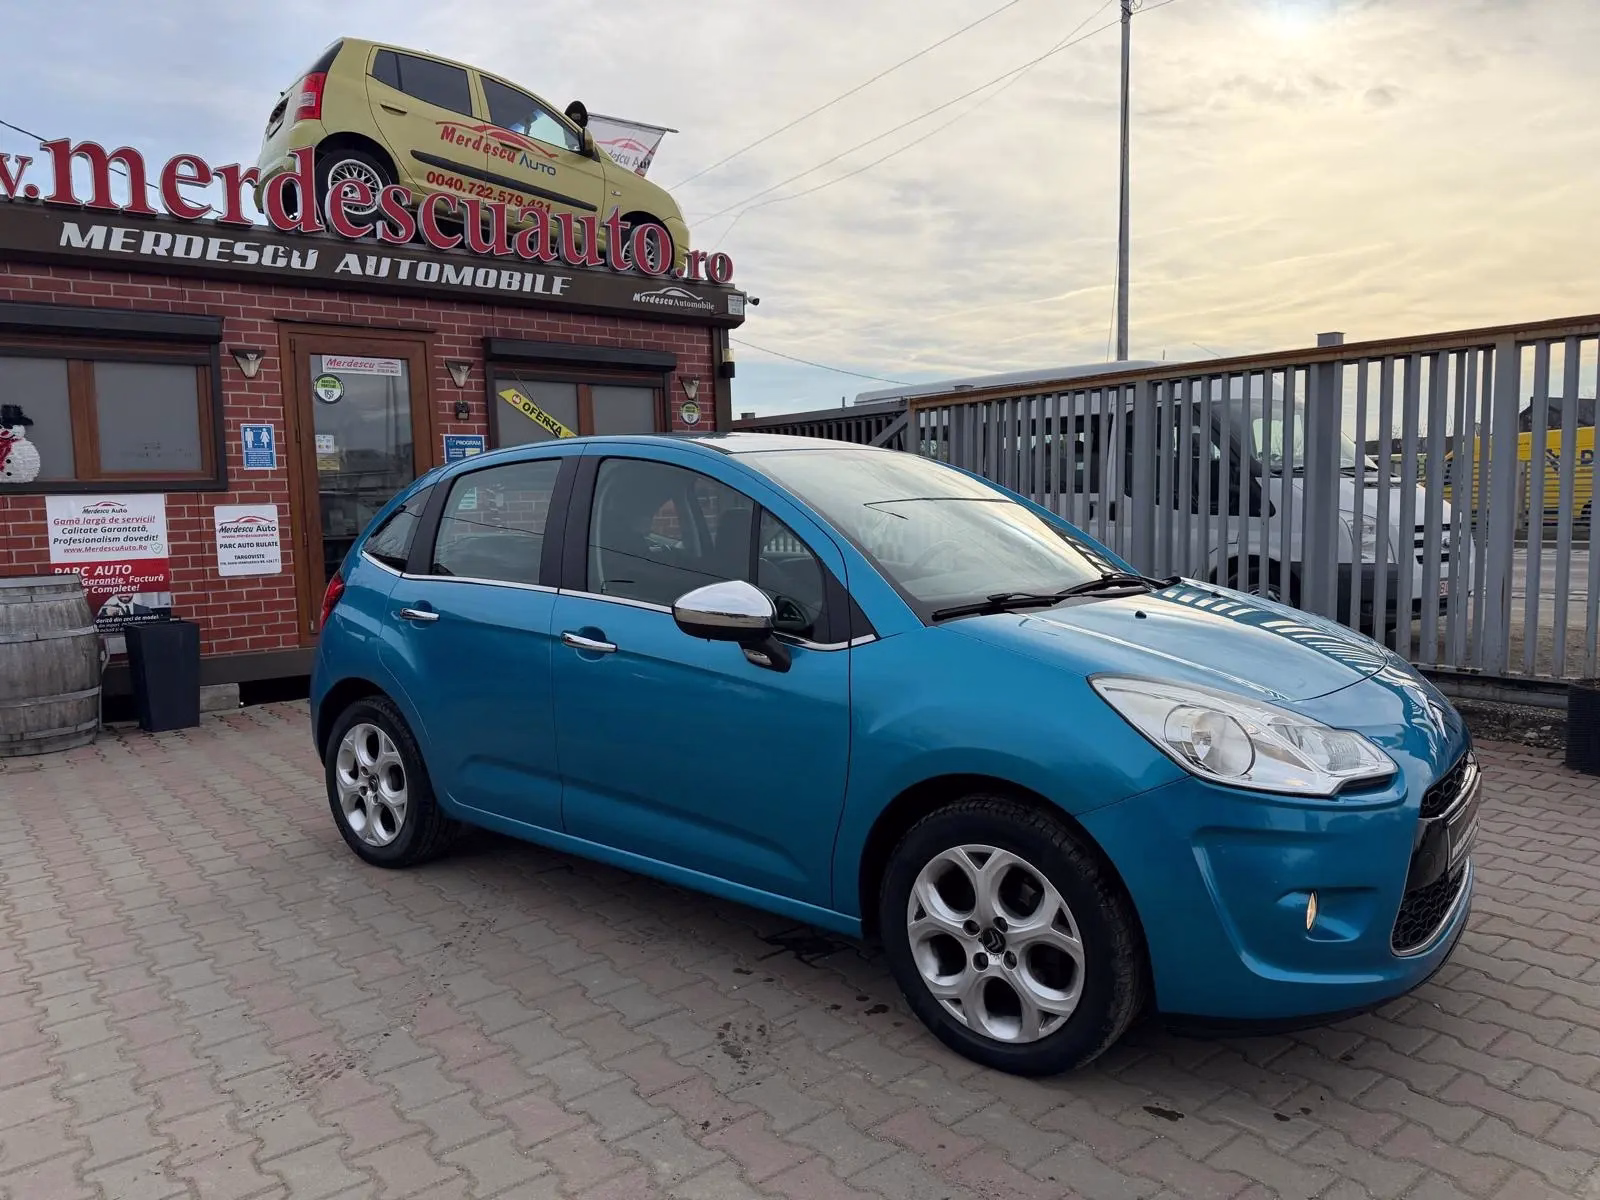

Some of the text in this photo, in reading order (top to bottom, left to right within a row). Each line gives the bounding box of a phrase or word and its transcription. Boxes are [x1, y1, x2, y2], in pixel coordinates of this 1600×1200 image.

[440, 125, 517, 163] Merdescu
[59, 221, 572, 296] MERDESCU AUTOMOBILE
[326, 358, 375, 369] Merdescu
[522, 402, 562, 436] OFERTA
[108, 516, 119, 524] de
[61, 527, 98, 535] Calitate
[219, 525, 254, 533] Merdescu
[53, 534, 159, 546] Profesionalism dovedit!
[94, 564, 132, 576] AUTO
[91, 584, 140, 595] Complete!
